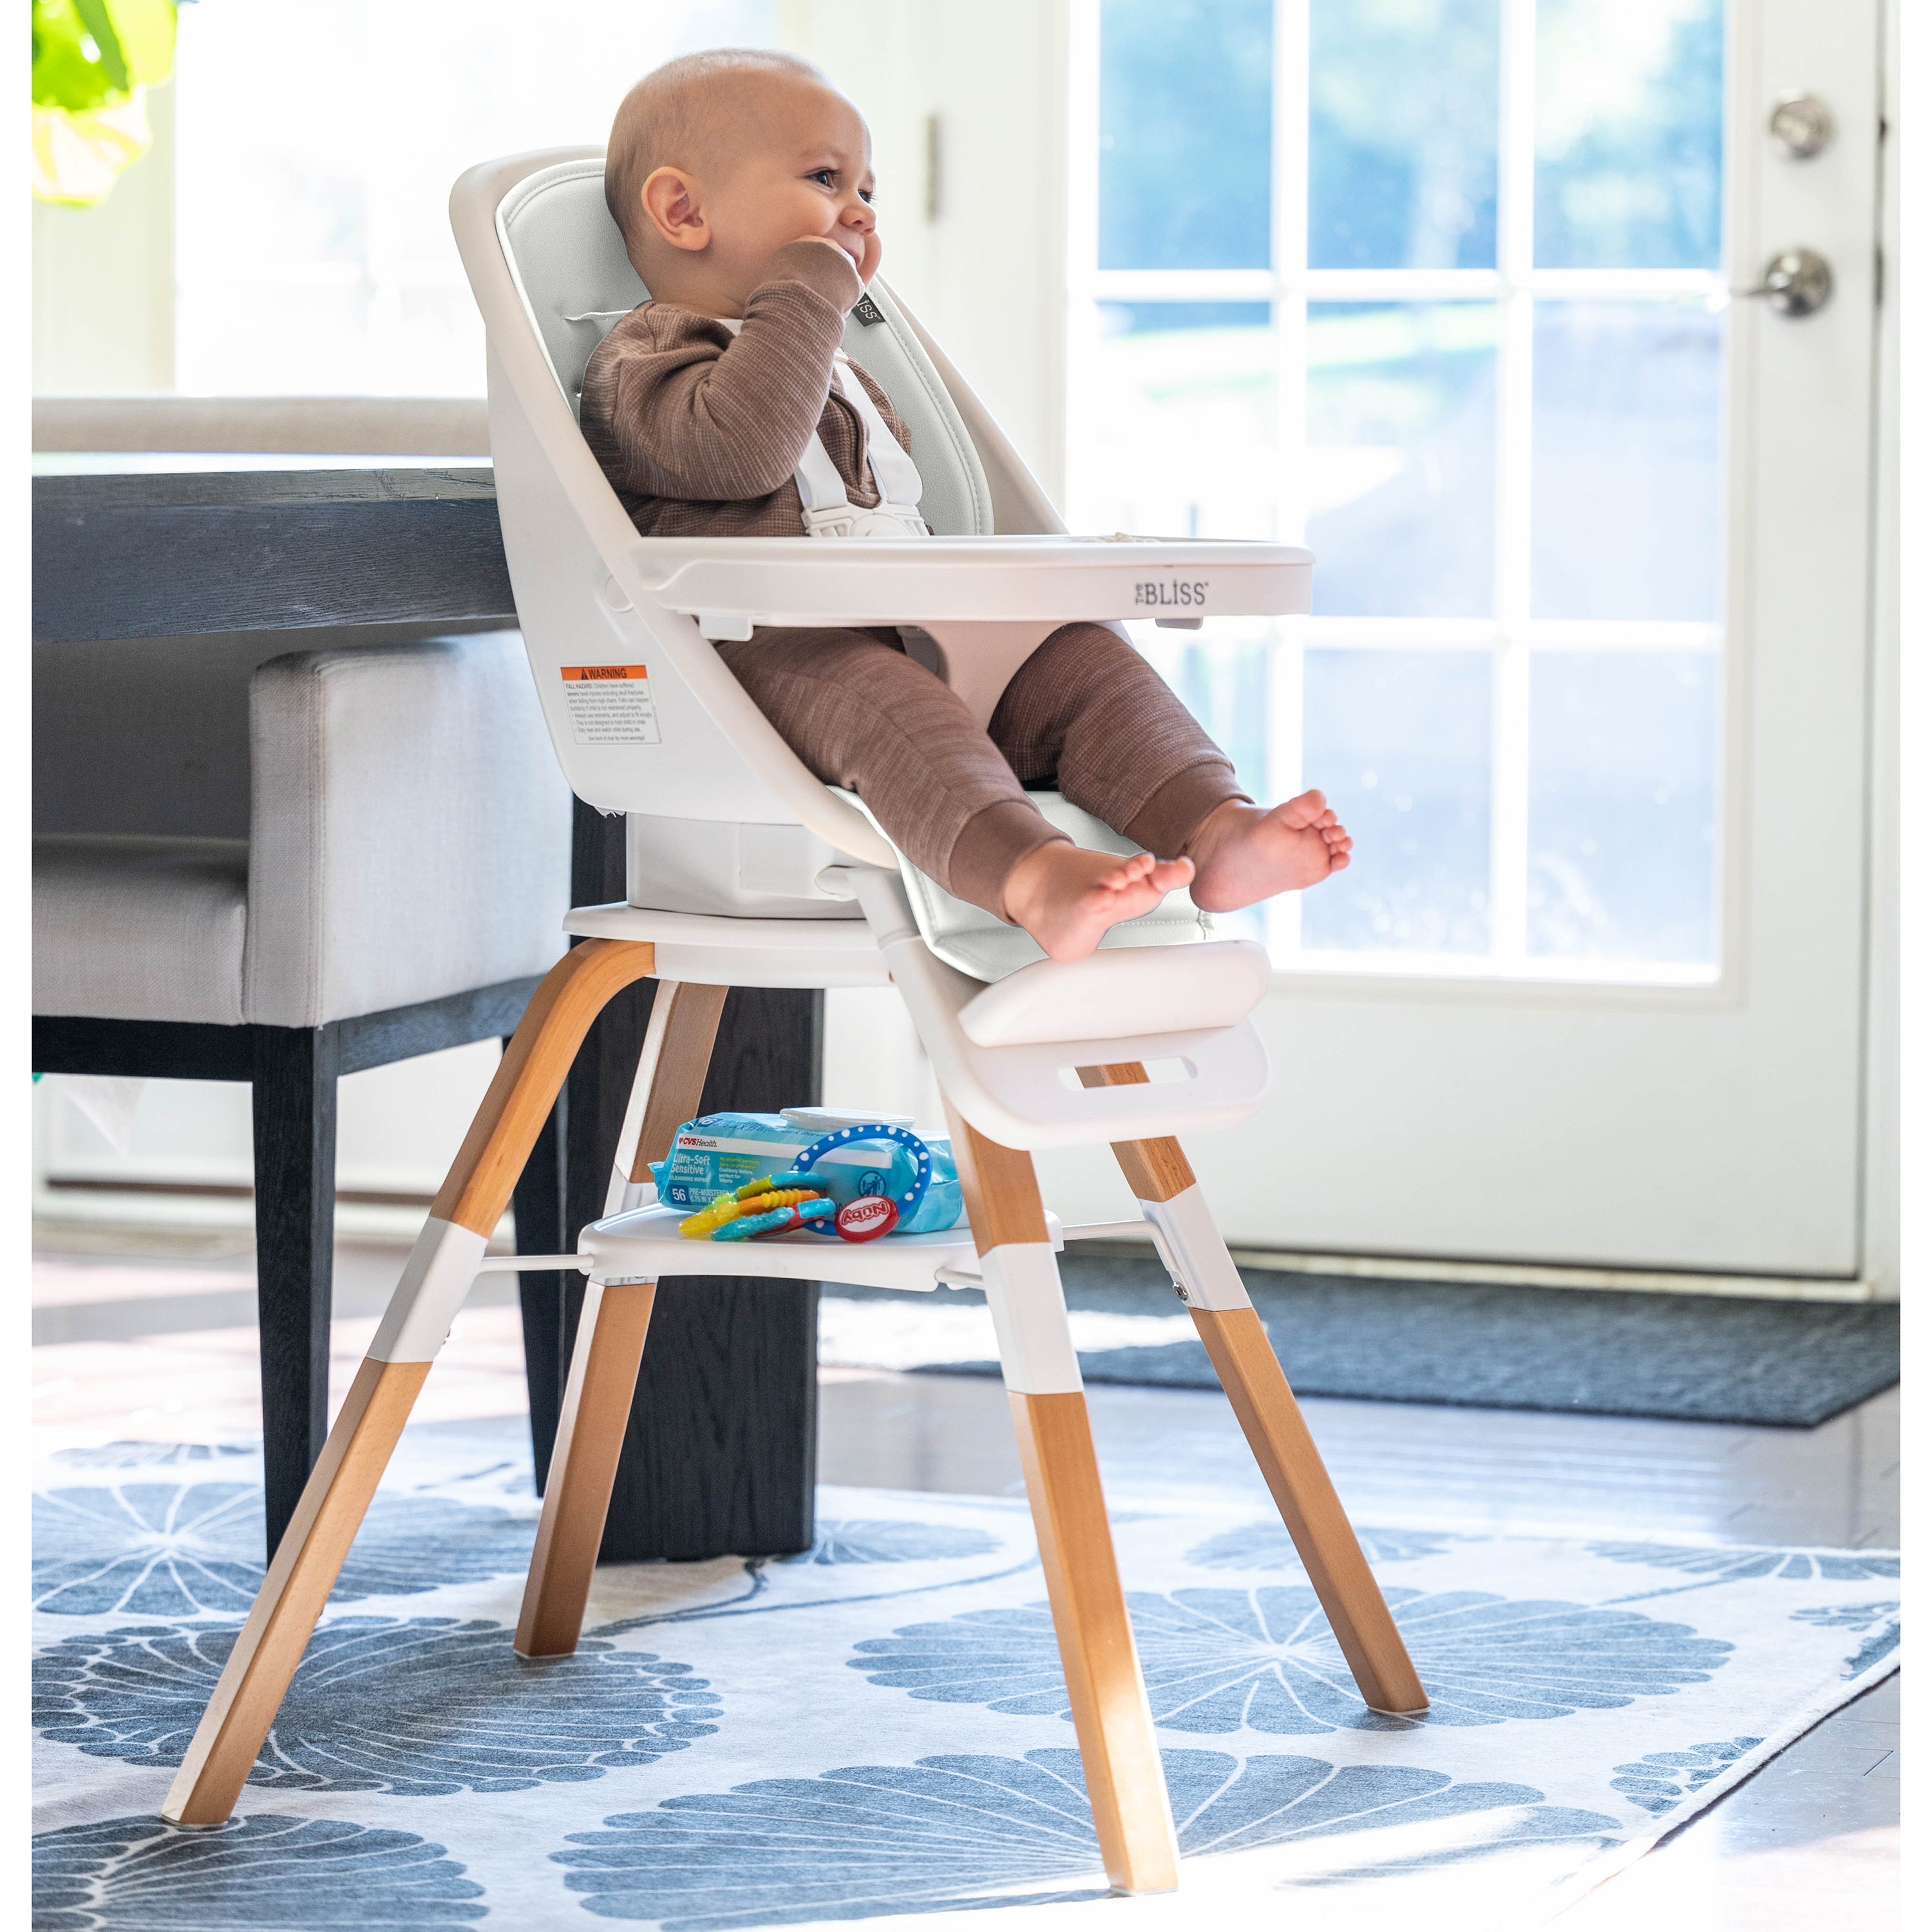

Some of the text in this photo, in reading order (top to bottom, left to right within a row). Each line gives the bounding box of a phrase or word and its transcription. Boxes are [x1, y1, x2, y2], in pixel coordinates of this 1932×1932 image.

[589, 668, 627, 679] WARNING
[674, 1153, 710, 1166] Ultra-Soft
[671, 1164, 704, 1175] Sensitive
[672, 1188, 687, 1201] 56
